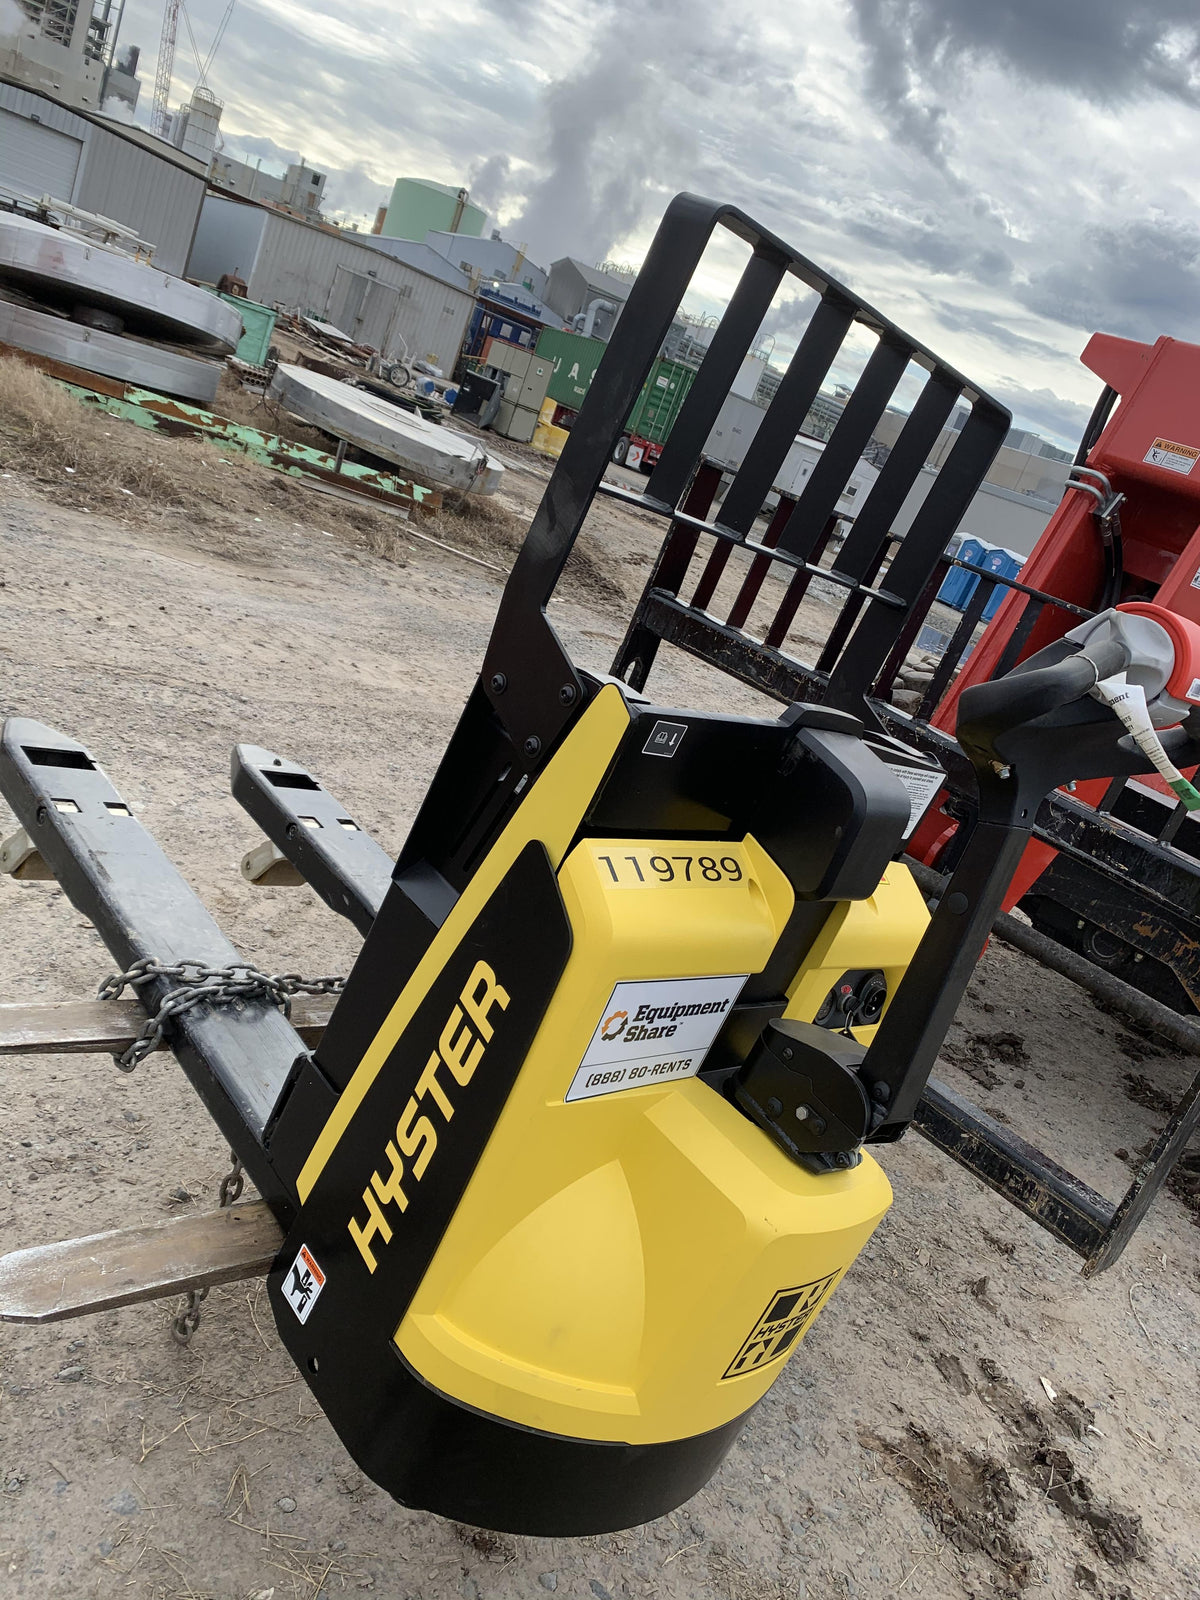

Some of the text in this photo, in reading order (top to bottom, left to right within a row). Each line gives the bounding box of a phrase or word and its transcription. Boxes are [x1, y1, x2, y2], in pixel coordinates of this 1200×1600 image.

[1164, 443, 1198, 458] WARNING
[597, 855, 743, 883] 119789
[632, 998, 730, 1024] Equipment
[622, 1024, 678, 1043] Share
[585, 1058, 693, 1088] (888) 80-RENTS
[347, 960, 511, 1275] HYSTER
[752, 1306, 814, 1340] HYSTER
